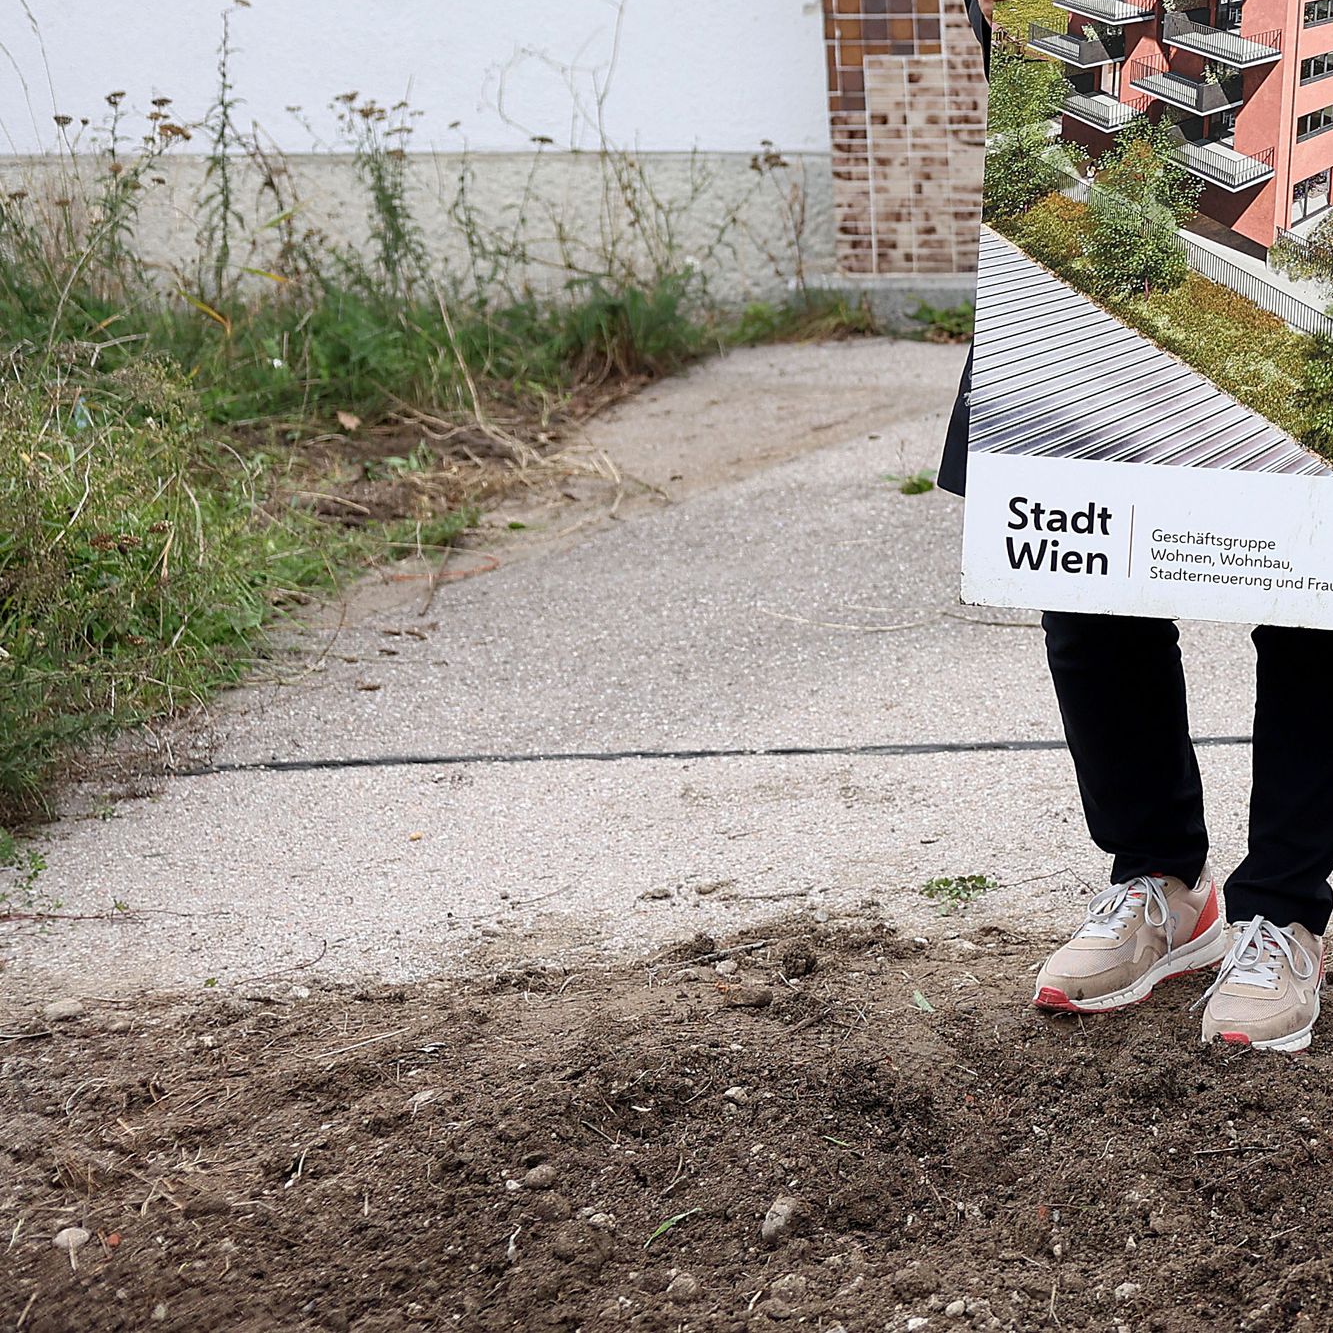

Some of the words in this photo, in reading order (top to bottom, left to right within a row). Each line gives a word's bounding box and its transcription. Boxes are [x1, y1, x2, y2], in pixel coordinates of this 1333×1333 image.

[1007, 496, 1113, 536] Stadt
[1151, 528, 1276, 553] Geschäftsgruppe
[1005, 536, 1109, 576] Wien
[1150, 547, 1216, 568] Wohnen,
[1219, 552, 1293, 573] Wohnbau,
[1149, 565, 1273, 591] Stadterneuerung
[1276, 576, 1304, 590] und
